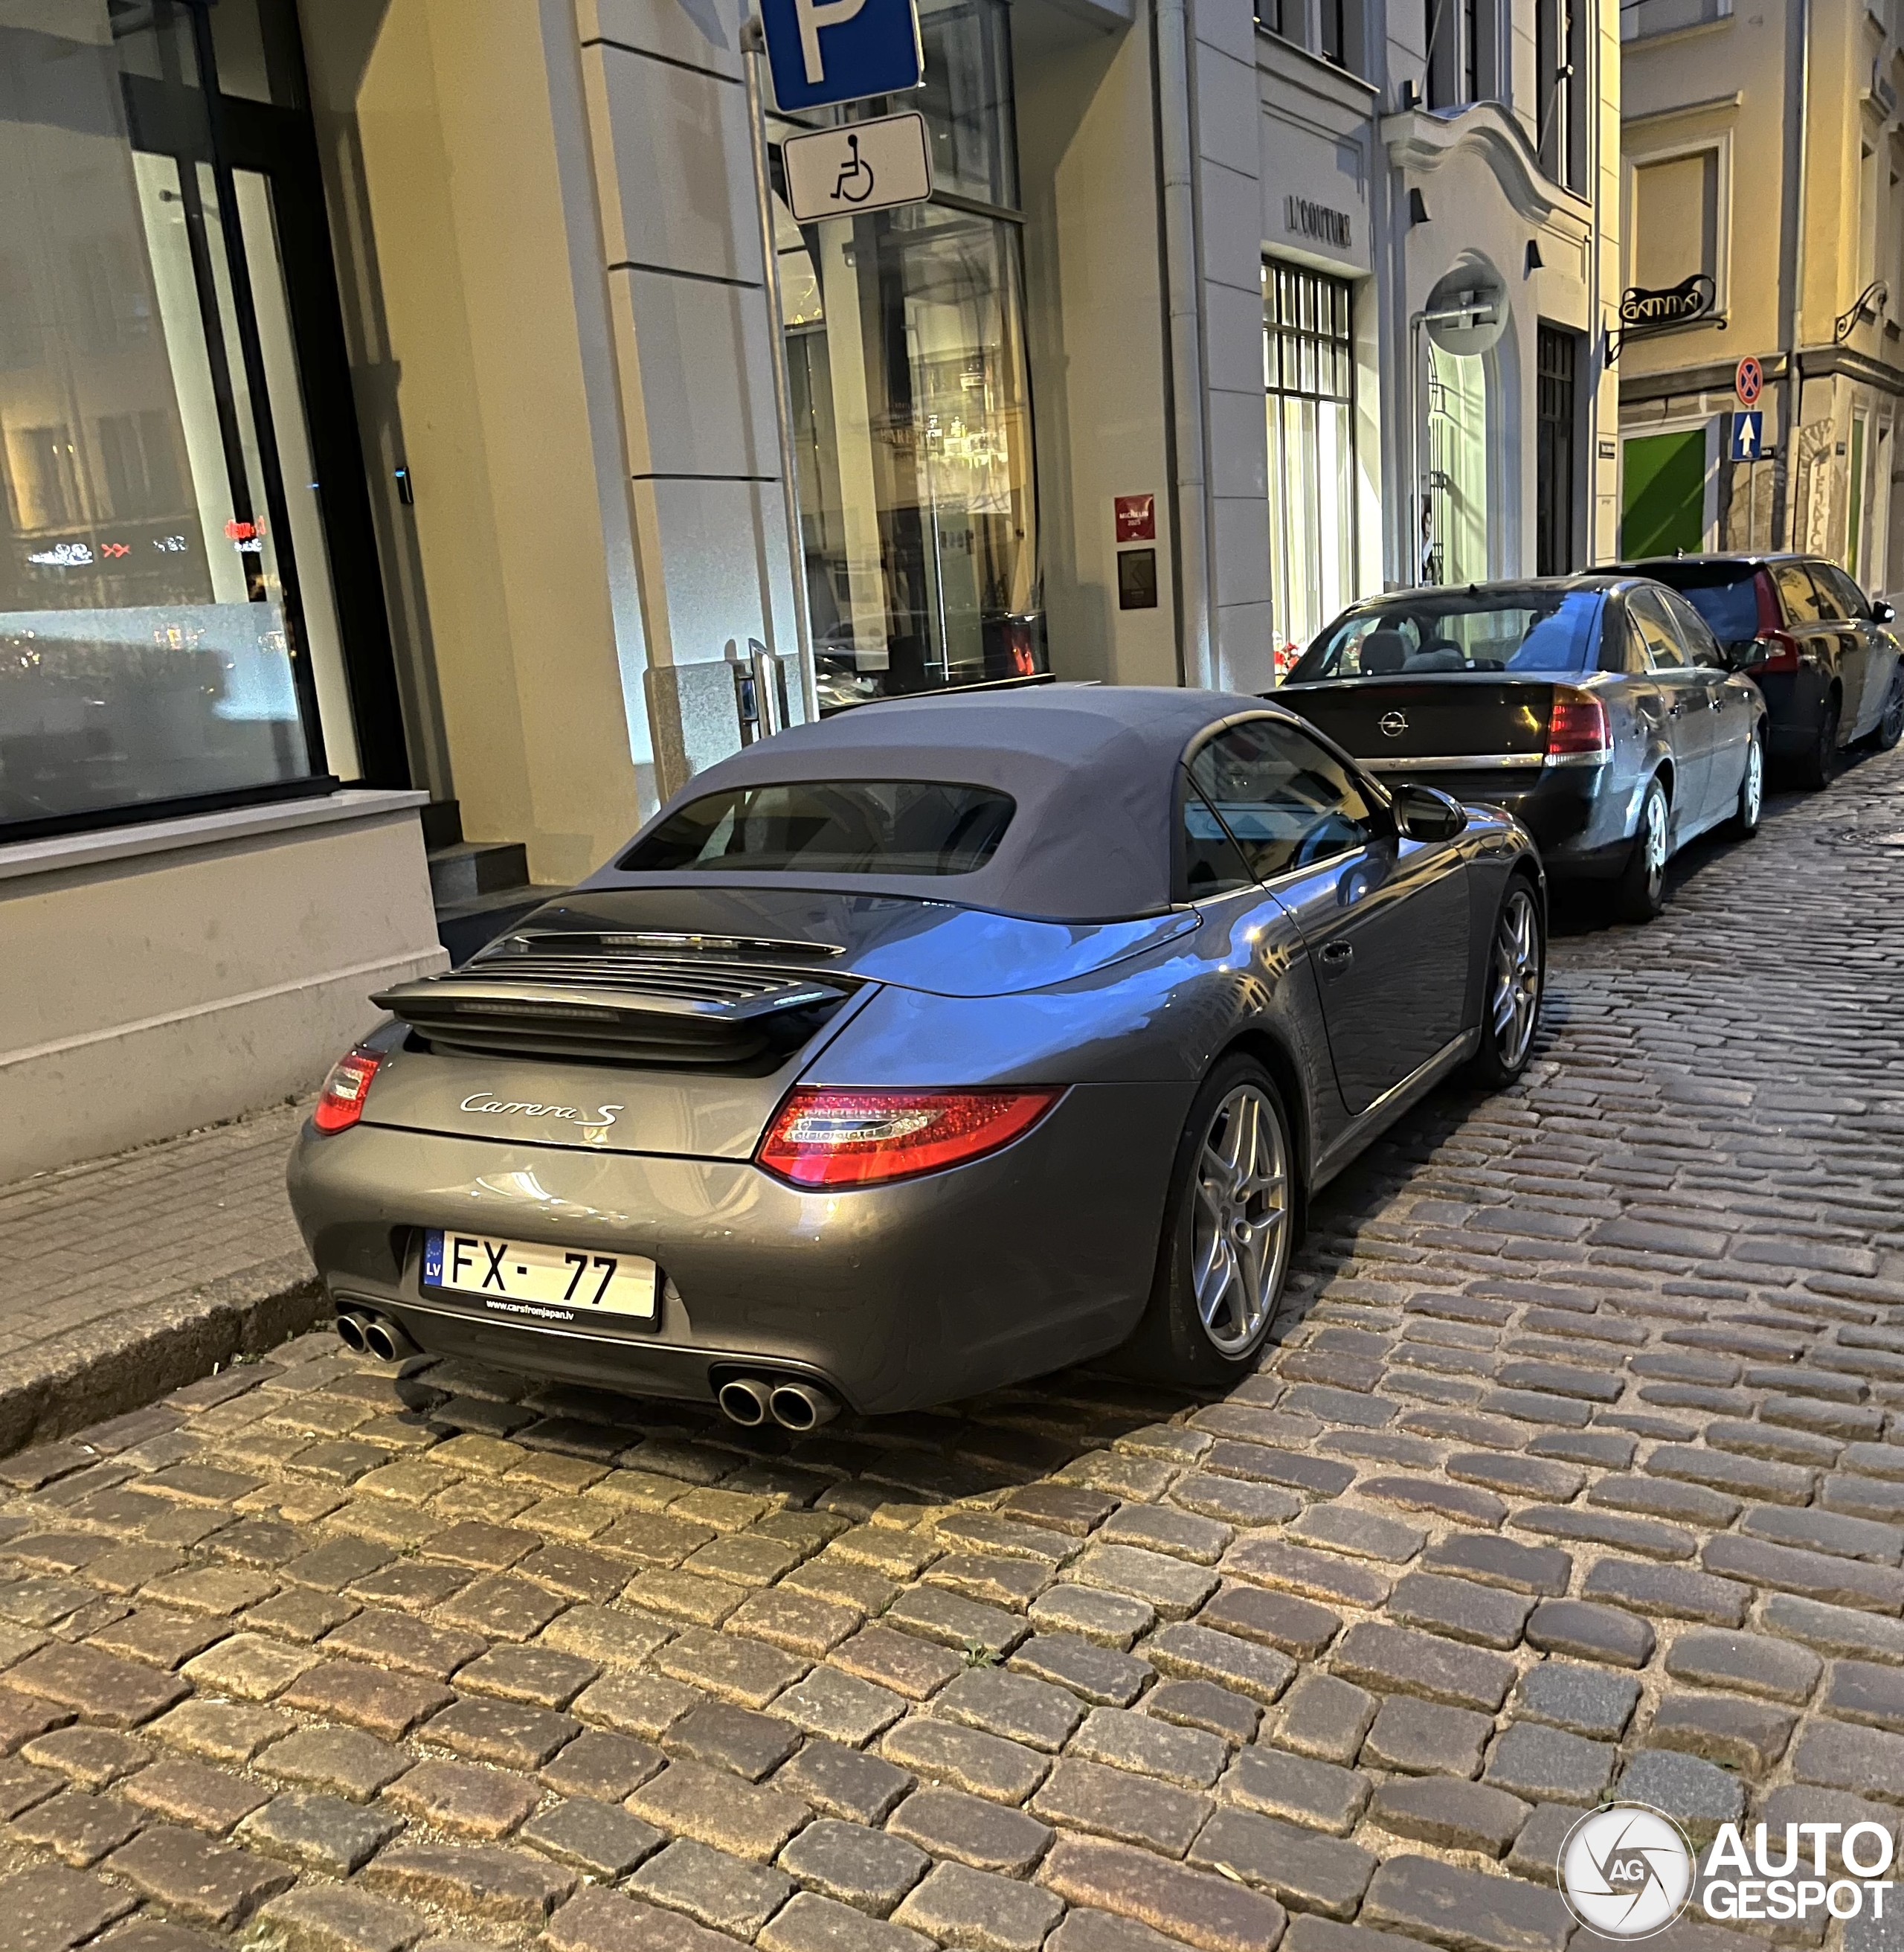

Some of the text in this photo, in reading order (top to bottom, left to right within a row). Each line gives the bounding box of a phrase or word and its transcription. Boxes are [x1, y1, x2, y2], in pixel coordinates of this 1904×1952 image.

[795, 0, 866, 84] P
[1622, 291, 1698, 319] GAMMA
[1119, 510, 1148, 519] MICHELIN
[460, 1092, 625, 1126] Carrera S
[426, 1262, 441, 1277] LV
[563, 1252, 617, 1305] 77
[486, 1300, 574, 1320] www.carsfromjapan.lv
